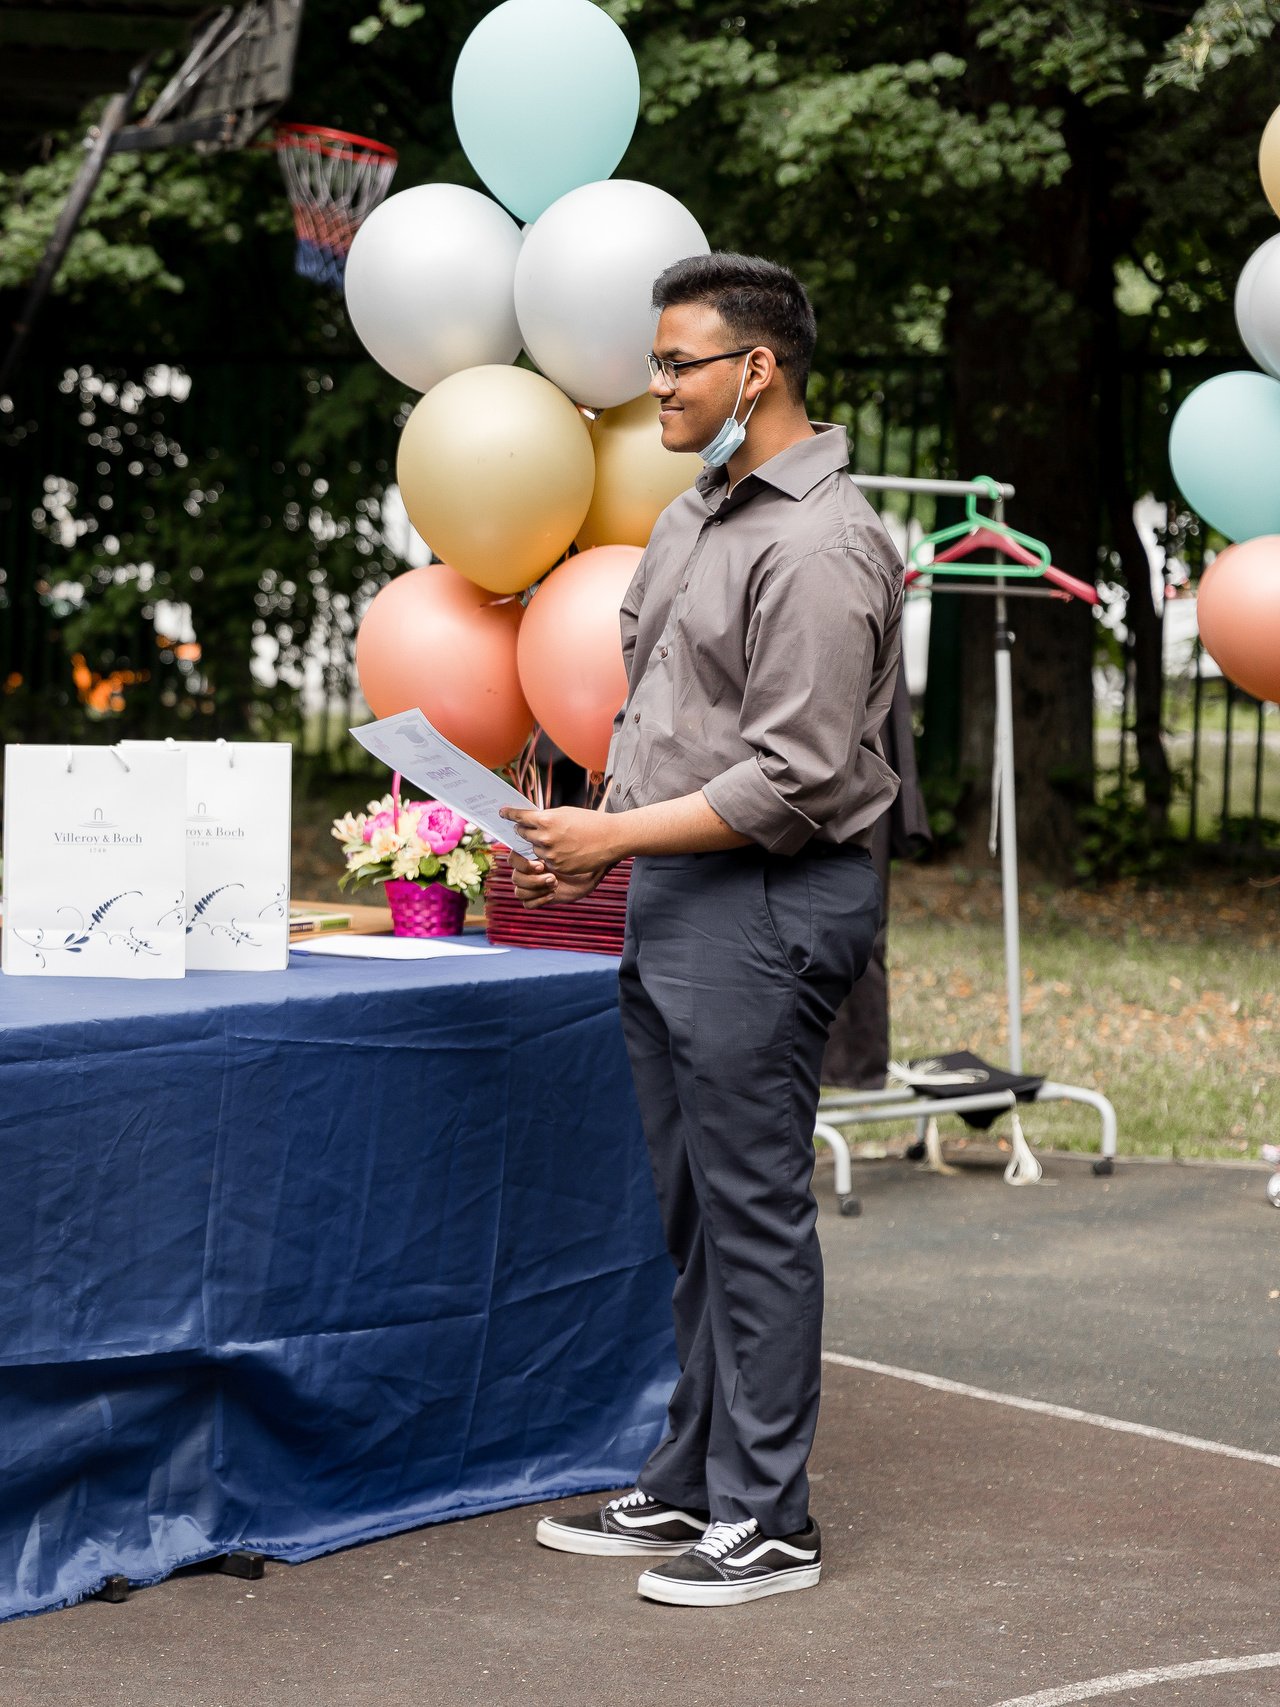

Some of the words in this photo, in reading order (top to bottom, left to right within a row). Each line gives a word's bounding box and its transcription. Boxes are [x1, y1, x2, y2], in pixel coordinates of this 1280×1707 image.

[205, 828, 213, 837] &
[216, 827, 245, 837] Boch
[54, 832, 100, 846] Villeroy
[102, 834, 110, 843] &
[113, 833, 142, 843] Boch
